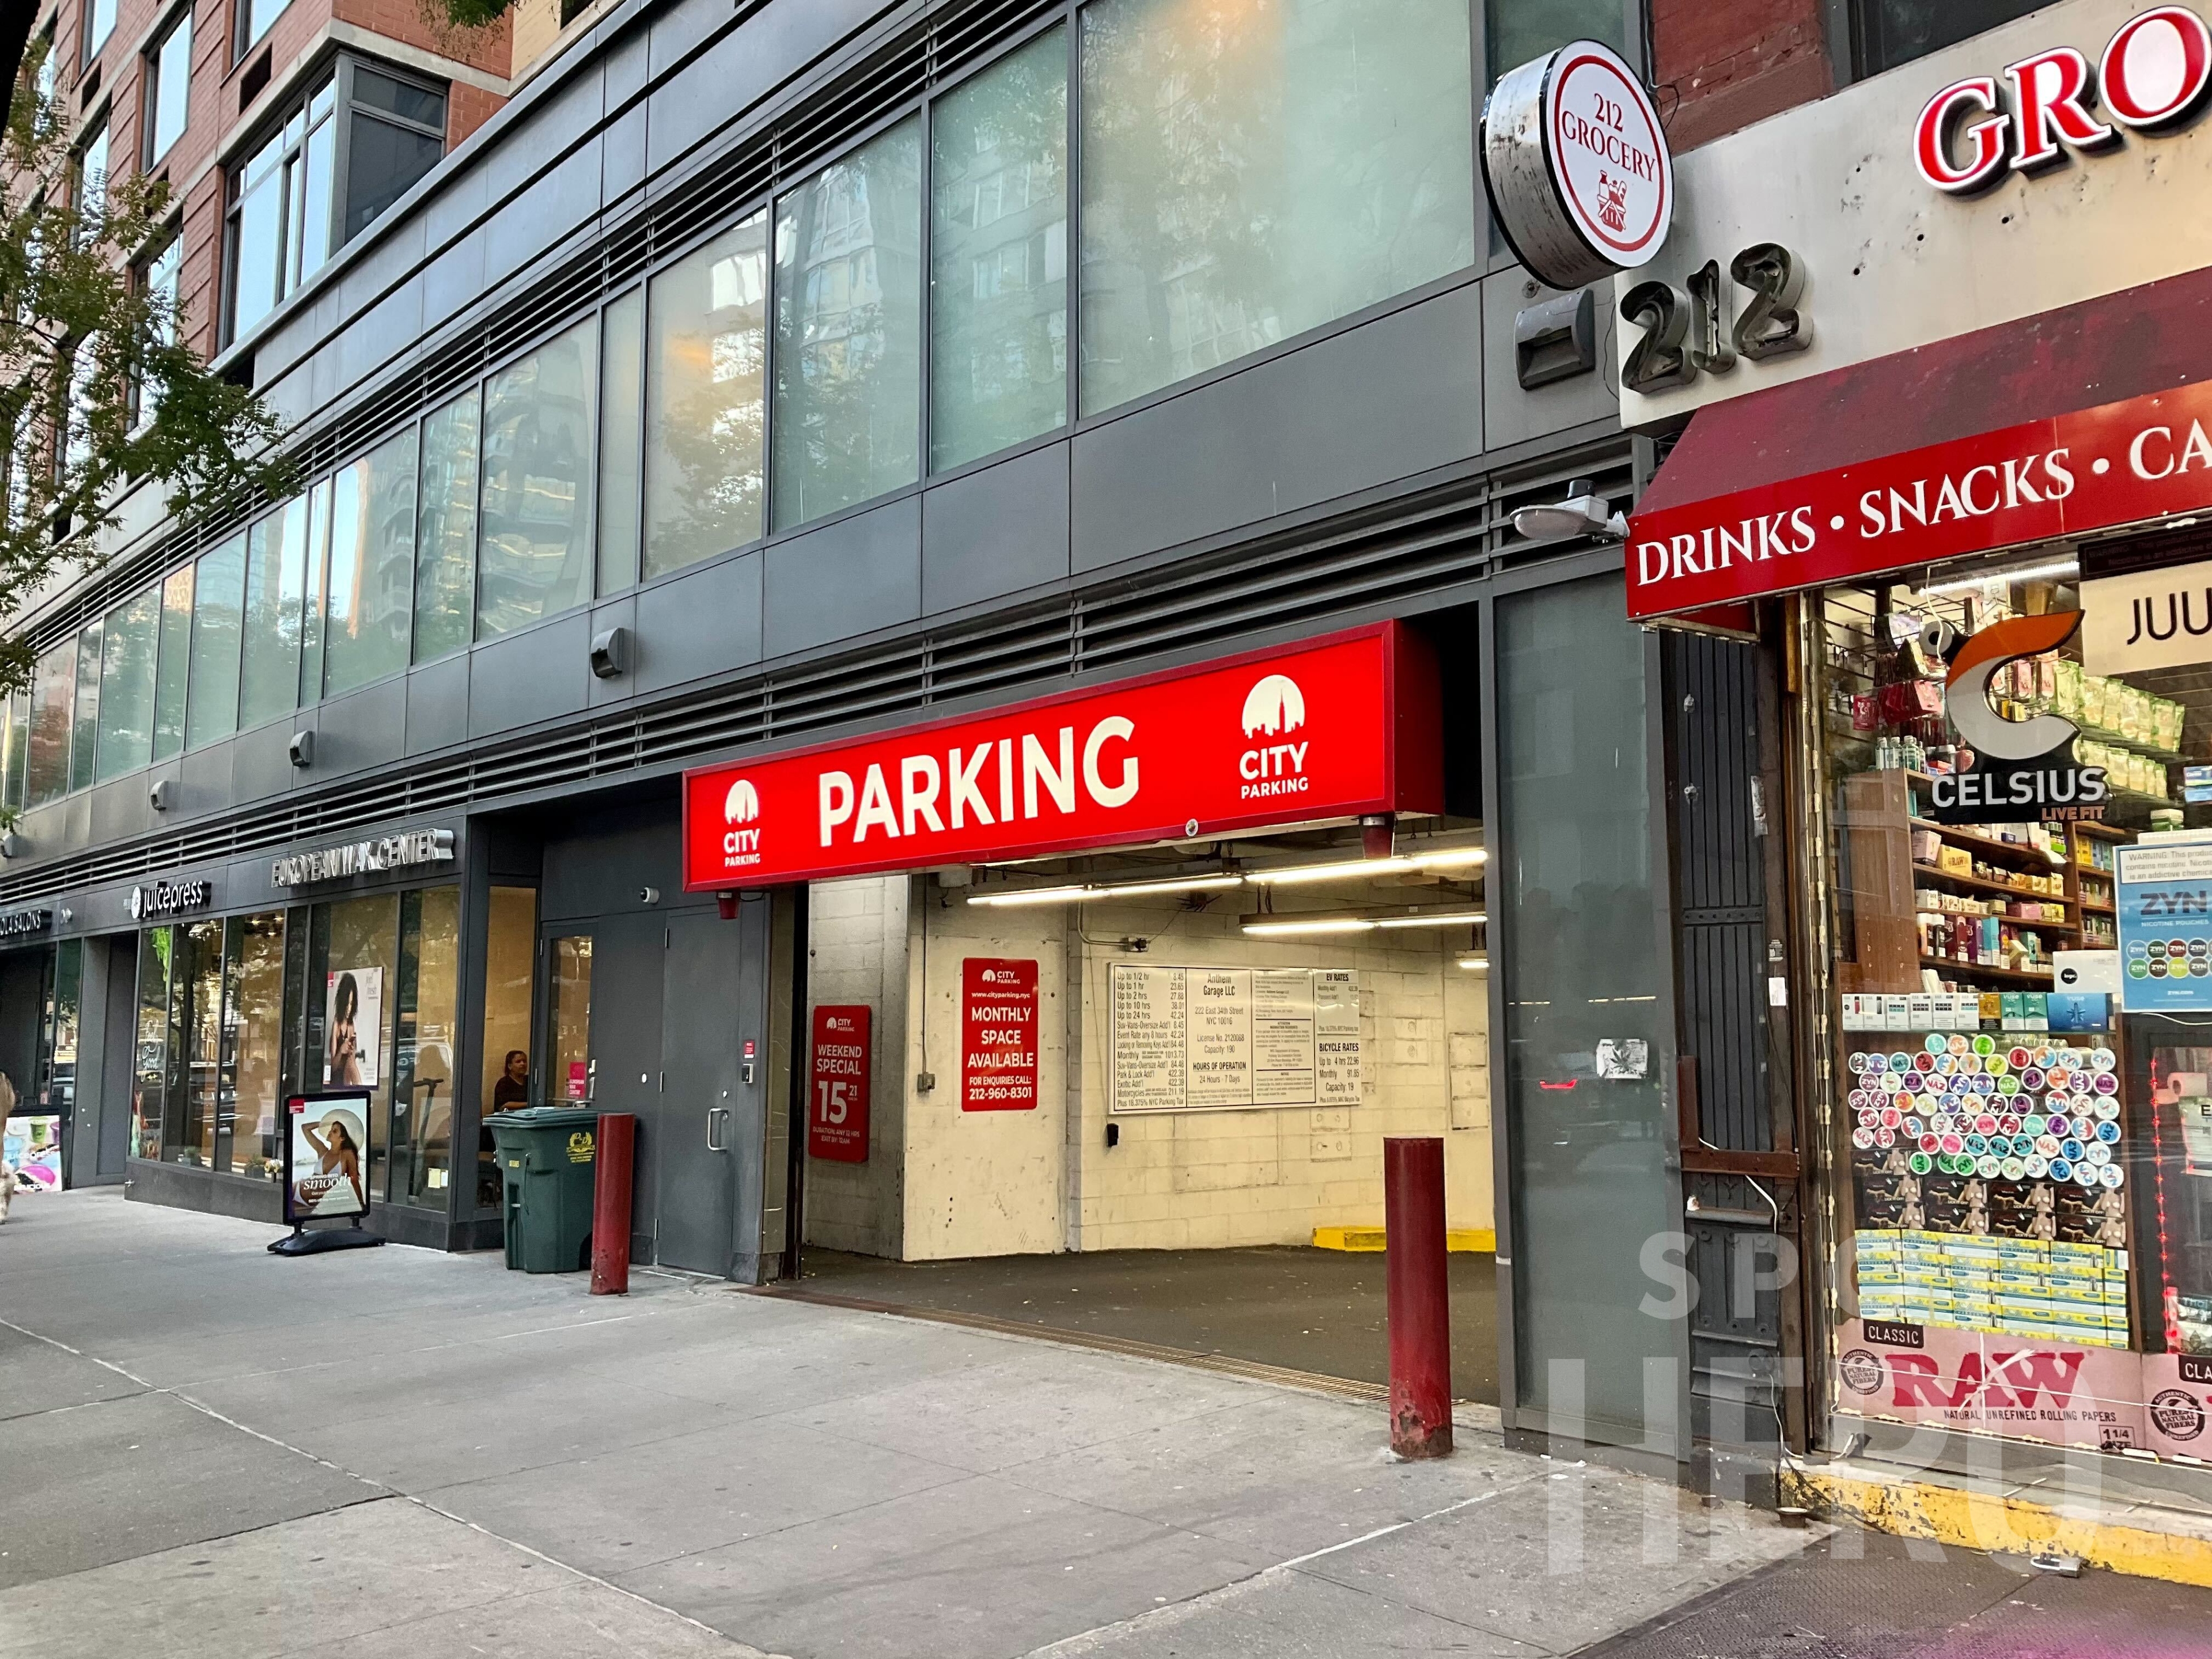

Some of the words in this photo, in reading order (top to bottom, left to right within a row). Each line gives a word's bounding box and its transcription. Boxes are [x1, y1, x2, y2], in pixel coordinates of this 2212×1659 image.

[1913, 5, 2212, 190] GRO
[1594, 93, 1624, 132] 212
[1562, 110, 1657, 183] GROCERY
[1620, 243, 1814, 394] 212
[1636, 505, 1816, 587] DRINKS
[1859, 447, 2075, 539] SNACKS
[1240, 741, 1308, 781] CITY
[819, 715, 1139, 847] PARKING
[1931, 767, 2105, 806] CELSIUS
[1241, 778, 1309, 800] PARKING
[2041, 806, 2078, 821] LIVE
[2080, 806, 2105, 820] FIT
[724, 828, 760, 854] CITY
[271, 847, 342, 888] EUROPEAN
[342, 839, 384, 876] WAX
[378, 828, 449, 869] CENTER
[725, 854, 761, 868] PARKING
[143, 881, 203, 918] juicepress
[2141, 891, 2207, 915] ZYN
[997, 971, 1015, 979] CITY
[1118, 972, 1124, 981] Up
[1126, 972, 1131, 980] to
[1134, 972, 1142, 980] 1/2
[1207, 973, 1231, 984] Anthem
[1326, 973, 1333, 981] EV
[1334, 973, 1349, 982] RATES
[1118, 982, 1124, 991] Up
[1126, 982, 1131, 990] to
[1134, 982, 1136, 990] 1
[1171, 982, 1184, 990] 23.65
[1203, 985, 1224, 998] Garage
[1225, 986, 1235, 995] LLC
[972, 1007, 1031, 1021] MONTHLY
[1118, 1011, 1124, 1020] Up
[1133, 1011, 1140, 1019] 24
[1195, 1006, 1205, 1014] 222
[1205, 1006, 1216, 1014] East
[1217, 1006, 1228, 1014] 34th
[1229, 1006, 1244, 1014] Street
[838, 1018, 851, 1027] CITY
[1206, 1017, 1217, 1025] NYC
[1218, 1017, 1233, 1025] 10016
[981, 1030, 1021, 1044] SPACE
[817, 1044, 862, 1058] WEEKEND
[1319, 1043, 1342, 1052] BICYCLE
[1342, 1043, 1359, 1051] RATES
[968, 1052, 1033, 1068] AVAILABLE
[1118, 1051, 1139, 1060] Monthly
[1165, 1051, 1184, 1059] 1013.73
[1319, 1056, 1325, 1066] Up
[1326, 1056, 1331, 1065] to
[1334, 1057, 1338, 1065] 4
[1347, 1056, 1359, 1065] 22.96
[2093, 1054, 2113, 1066] ZYN
[816, 1059, 861, 1075] SPECIAL
[1193, 1062, 1210, 1070] HOURS
[1211, 1062, 1218, 1070] OF
[1219, 1061, 1247, 1070] OPERATION
[969, 1076, 982, 1086] FOR
[983, 1075, 1014, 1086] ENQUIRIES
[1016, 1075, 1032, 1084] CALL:
[1926, 1080, 1946, 1091] ZYN
[1974, 1081, 1994, 1089] ZYN
[969, 1086, 1032, 1100] 212-960-8301
[818, 1081, 847, 1124] 15
[849, 1085, 857, 1096] 21
[1118, 1099, 1127, 1107] Plus
[1159, 1098, 1176, 1106] Parking
[1851, 1094, 1865, 1106] ZYN
[1860, 1113, 1877, 1125] ZYN
[812, 1126, 835, 1135] DURATION:
[1967, 1138, 1985, 1151] ZYN
[2013, 1138, 2032, 1150] ZYN
[2037, 1140, 2056, 1153] ZYN
[1915, 1154, 1925, 1172] ZYN
[303, 1172, 351, 1190] smooth
[1868, 1325, 1919, 1345] CLASSIC
[1843, 1351, 1873, 1362] AUTHENTIC
[1848, 1371, 1877, 1379] NATURAL
[1852, 1377, 1877, 1385] FIBERS
[1885, 1352, 2085, 1409] RAW
[2155, 1391, 2191, 1404] AUTHENTIC
[1944, 1410, 1980, 1420] NATURAL
[1986, 1410, 2037, 1421] UNREFINED
[2040, 1410, 2077, 1421] ROLLING
[2082, 1411, 2116, 1422] PAPERS
[2161, 1414, 2196, 1423] NATURAL
[2165, 1420, 2196, 1429] FIBERS
[2103, 1429, 2111, 1440] 1
[2113, 1429, 2130, 1438] 1/4
